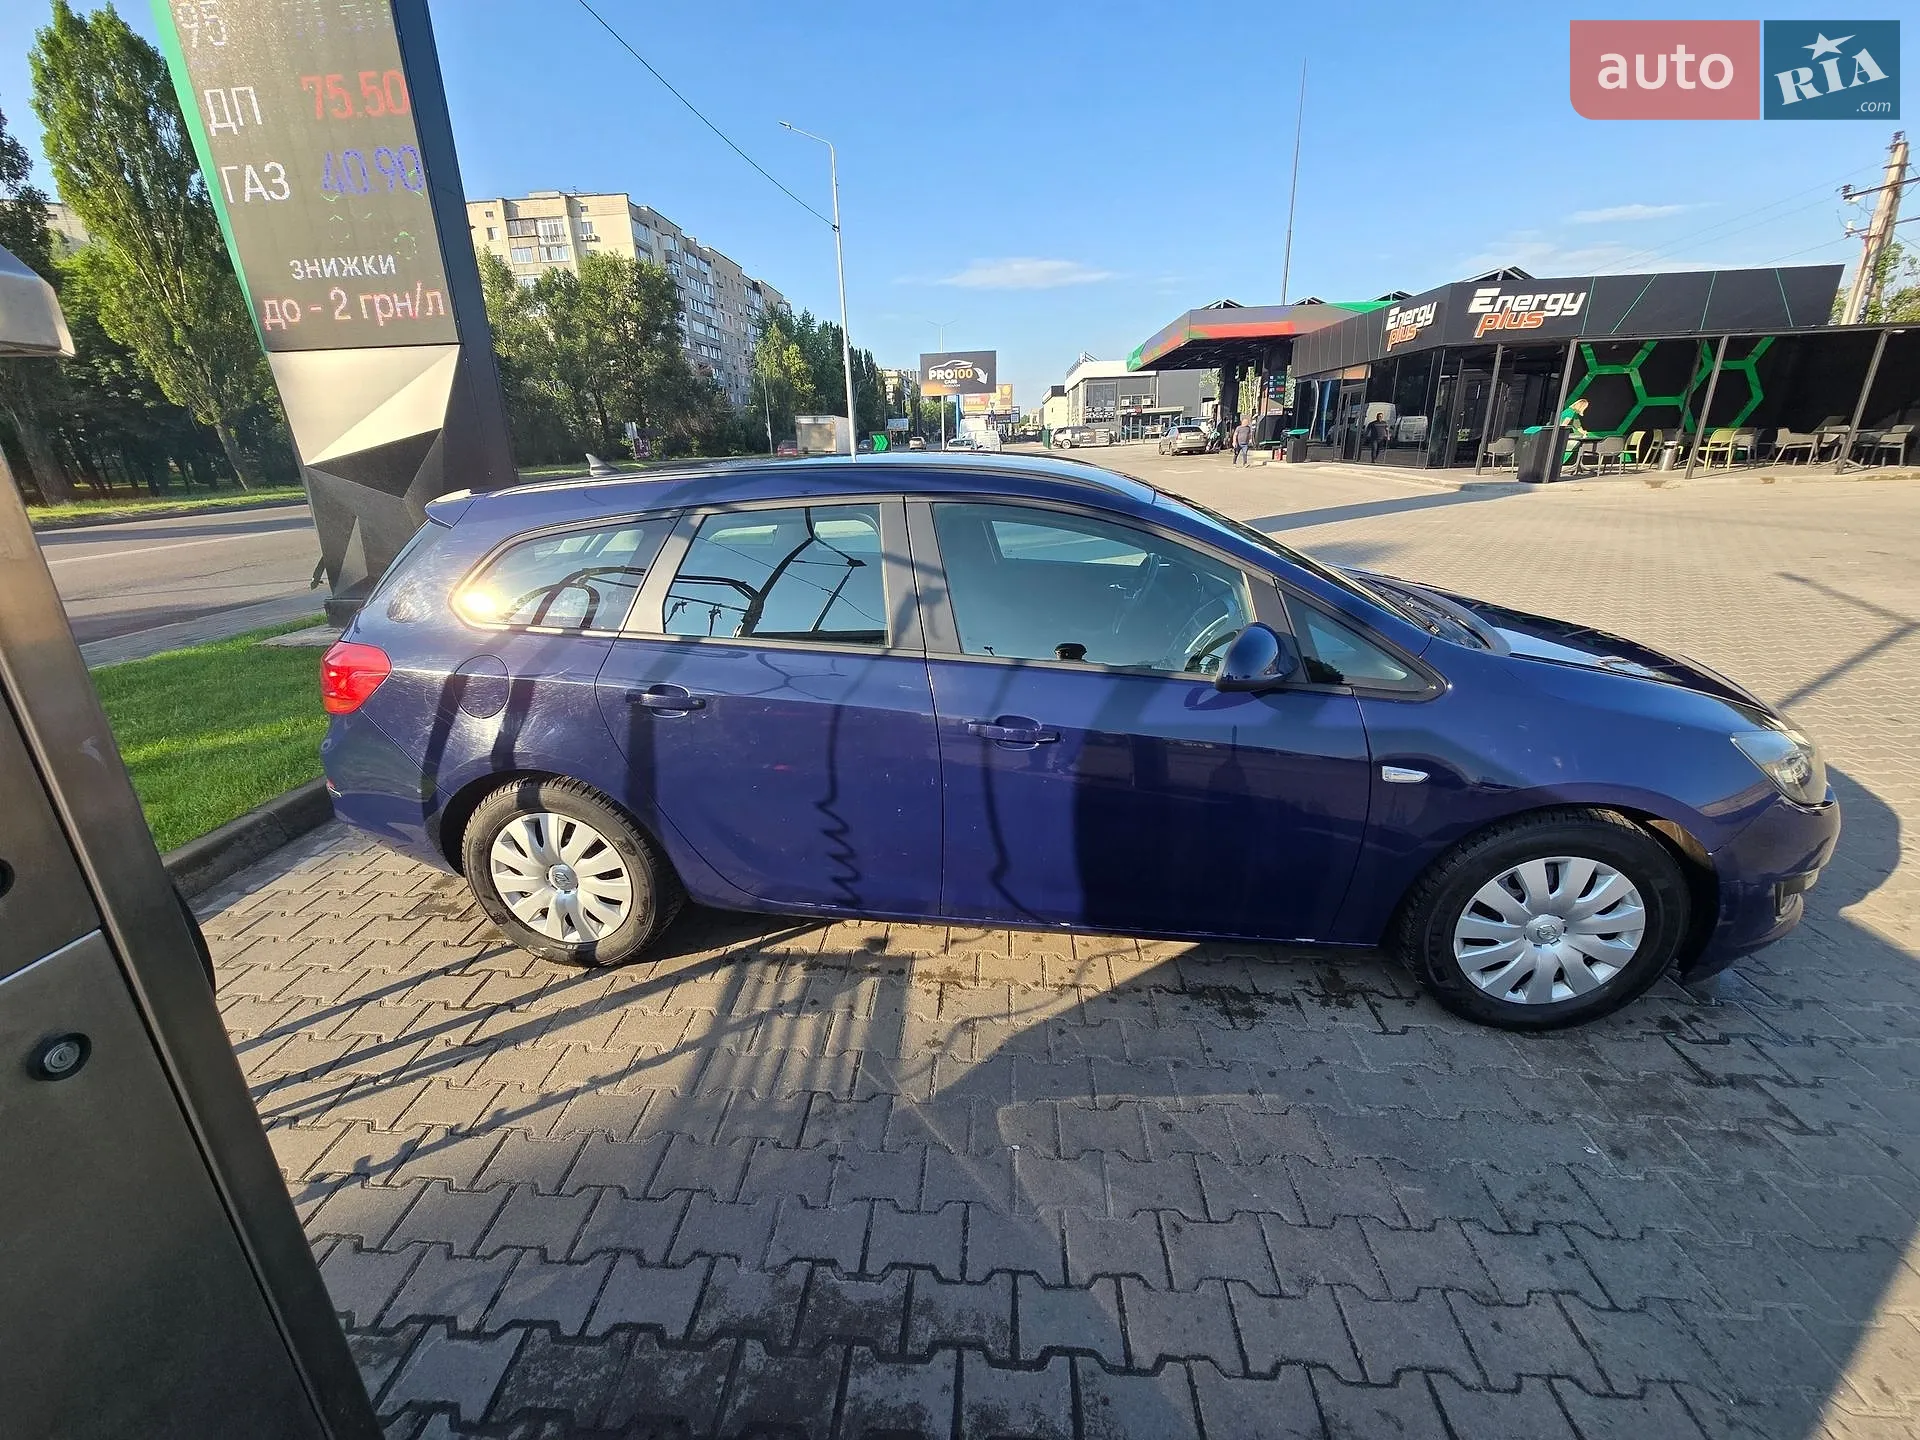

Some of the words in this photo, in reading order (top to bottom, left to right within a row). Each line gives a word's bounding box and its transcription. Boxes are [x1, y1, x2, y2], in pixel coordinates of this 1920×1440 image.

[179, 0, 228, 48] 95
[204, 86, 263, 136] ДП
[302, 69, 411, 120] 75.50
[220, 161, 291, 203] ГАЗ
[263, 298, 301, 331] до
[330, 286, 352, 321] 2
[359, 280, 446, 327] грн/л
[1385, 302, 1437, 331] Energy
[1468, 287, 1586, 317] Energy
[1387, 323, 1418, 352] plus
[1474, 306, 1546, 338] plus
[928, 368, 973, 380] PRO100
